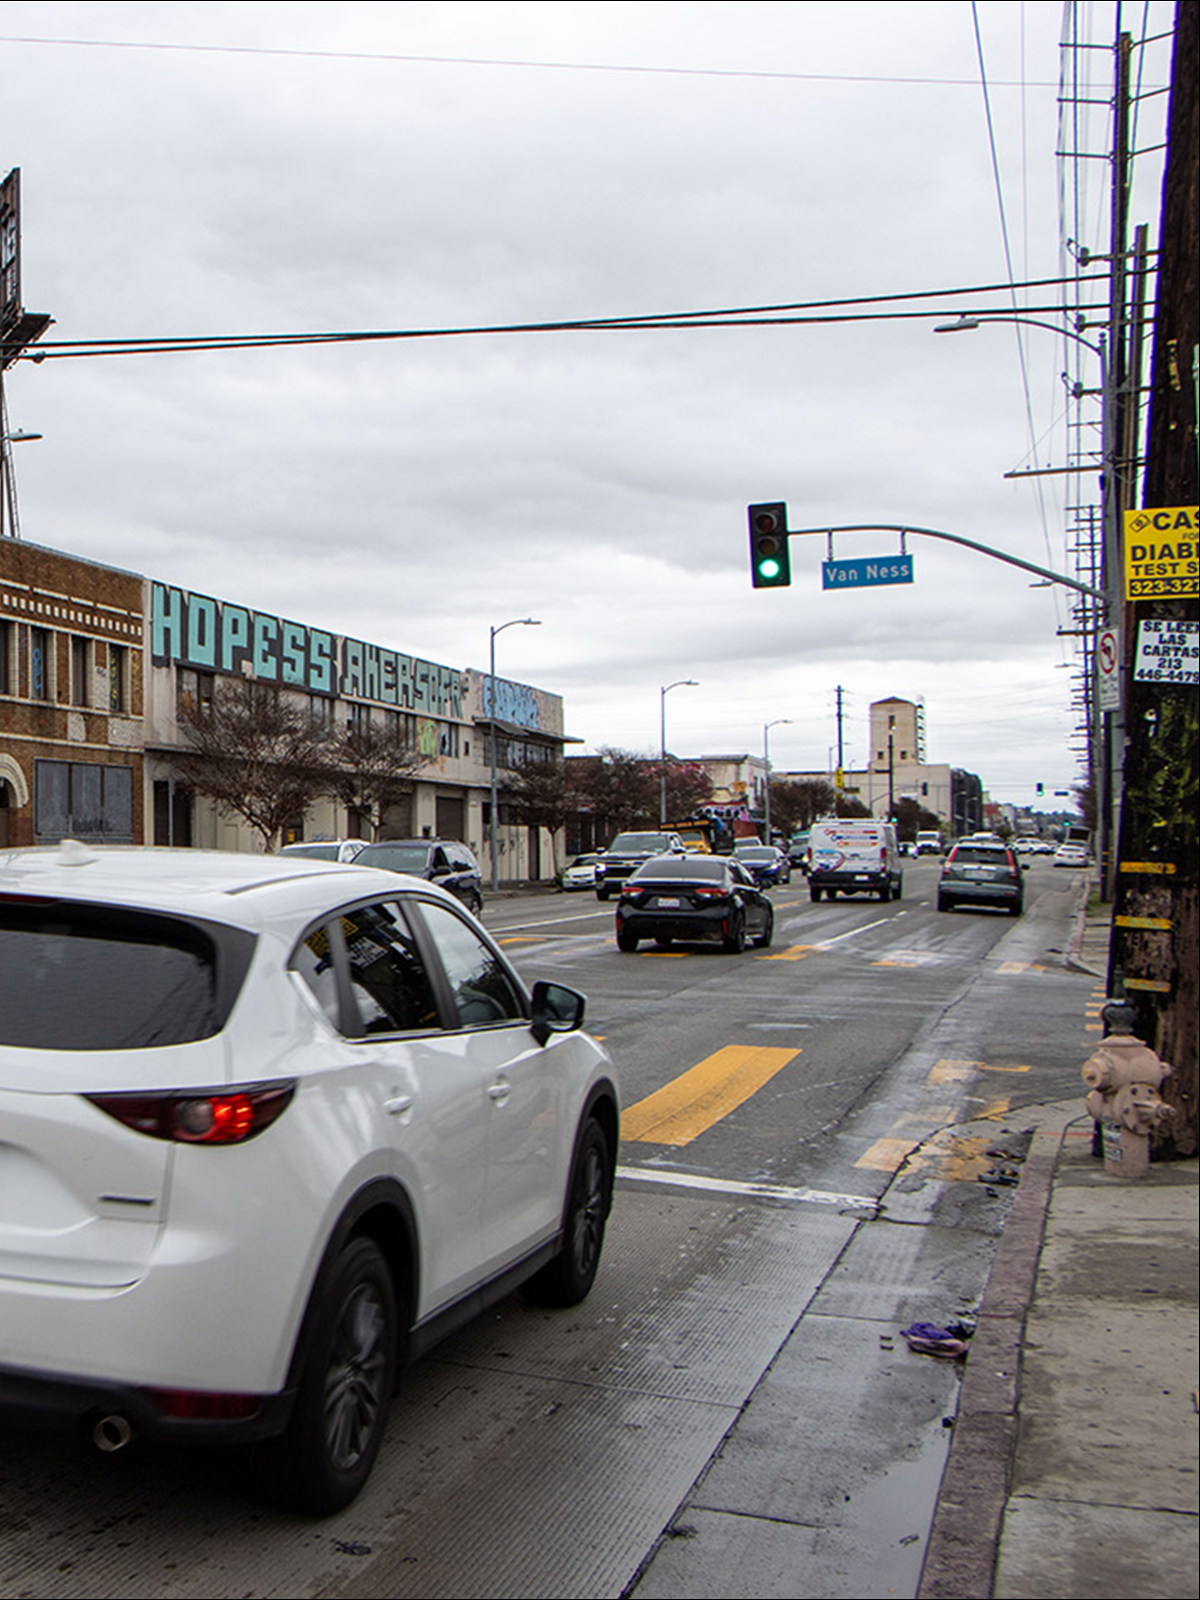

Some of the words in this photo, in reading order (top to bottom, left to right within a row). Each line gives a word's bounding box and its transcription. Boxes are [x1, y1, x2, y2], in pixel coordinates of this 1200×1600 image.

[826, 567, 858, 582] Van
[866, 564, 909, 579] Ness
[1131, 562, 1180, 576] TEST
[1143, 620, 1162, 633] SE
[1158, 633, 1186, 646] LAS
[1142, 644, 1199, 659] CARTAS
[1157, 657, 1182, 670] 213
